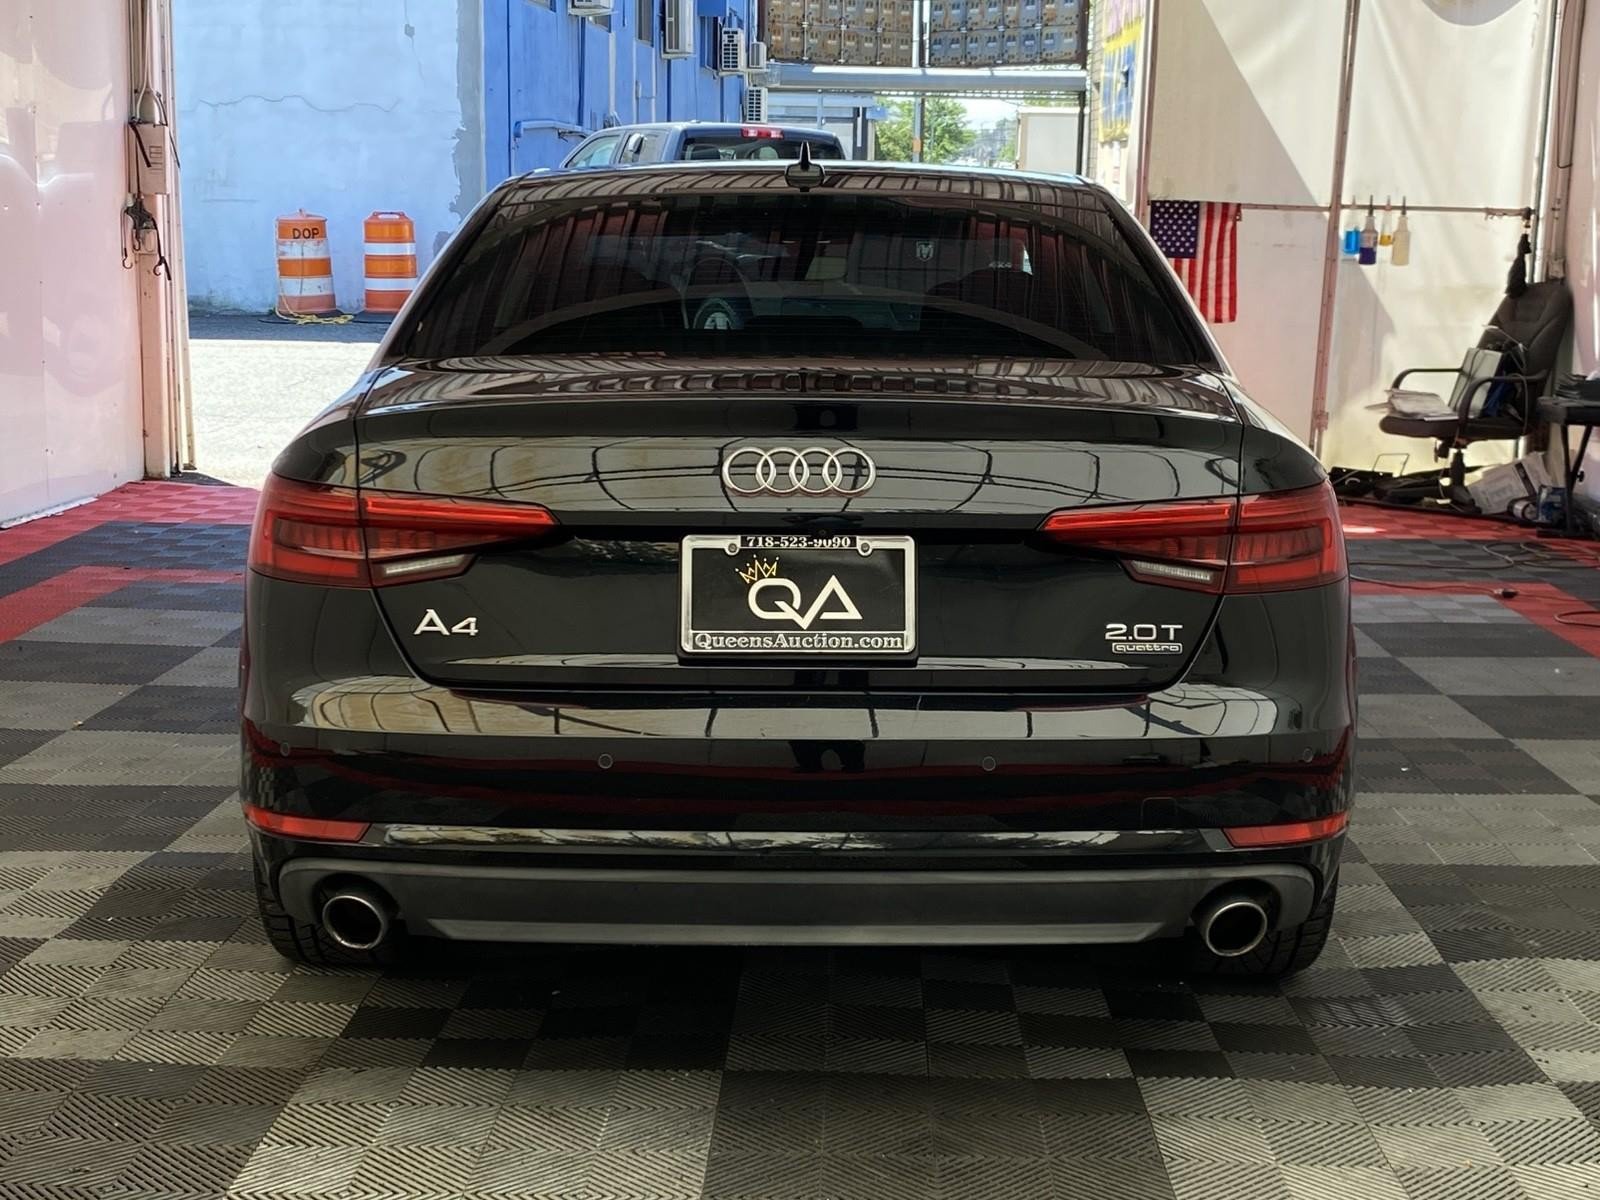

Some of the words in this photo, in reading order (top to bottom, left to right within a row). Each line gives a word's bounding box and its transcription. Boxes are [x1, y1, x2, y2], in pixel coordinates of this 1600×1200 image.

[292, 228, 320, 239] DOP
[746, 536, 851, 547] 718-523-9090
[748, 575, 863, 630] QA
[413, 608, 479, 636] A4
[695, 633, 903, 649] QueensAuction.com
[1115, 643, 1180, 653] quattro
